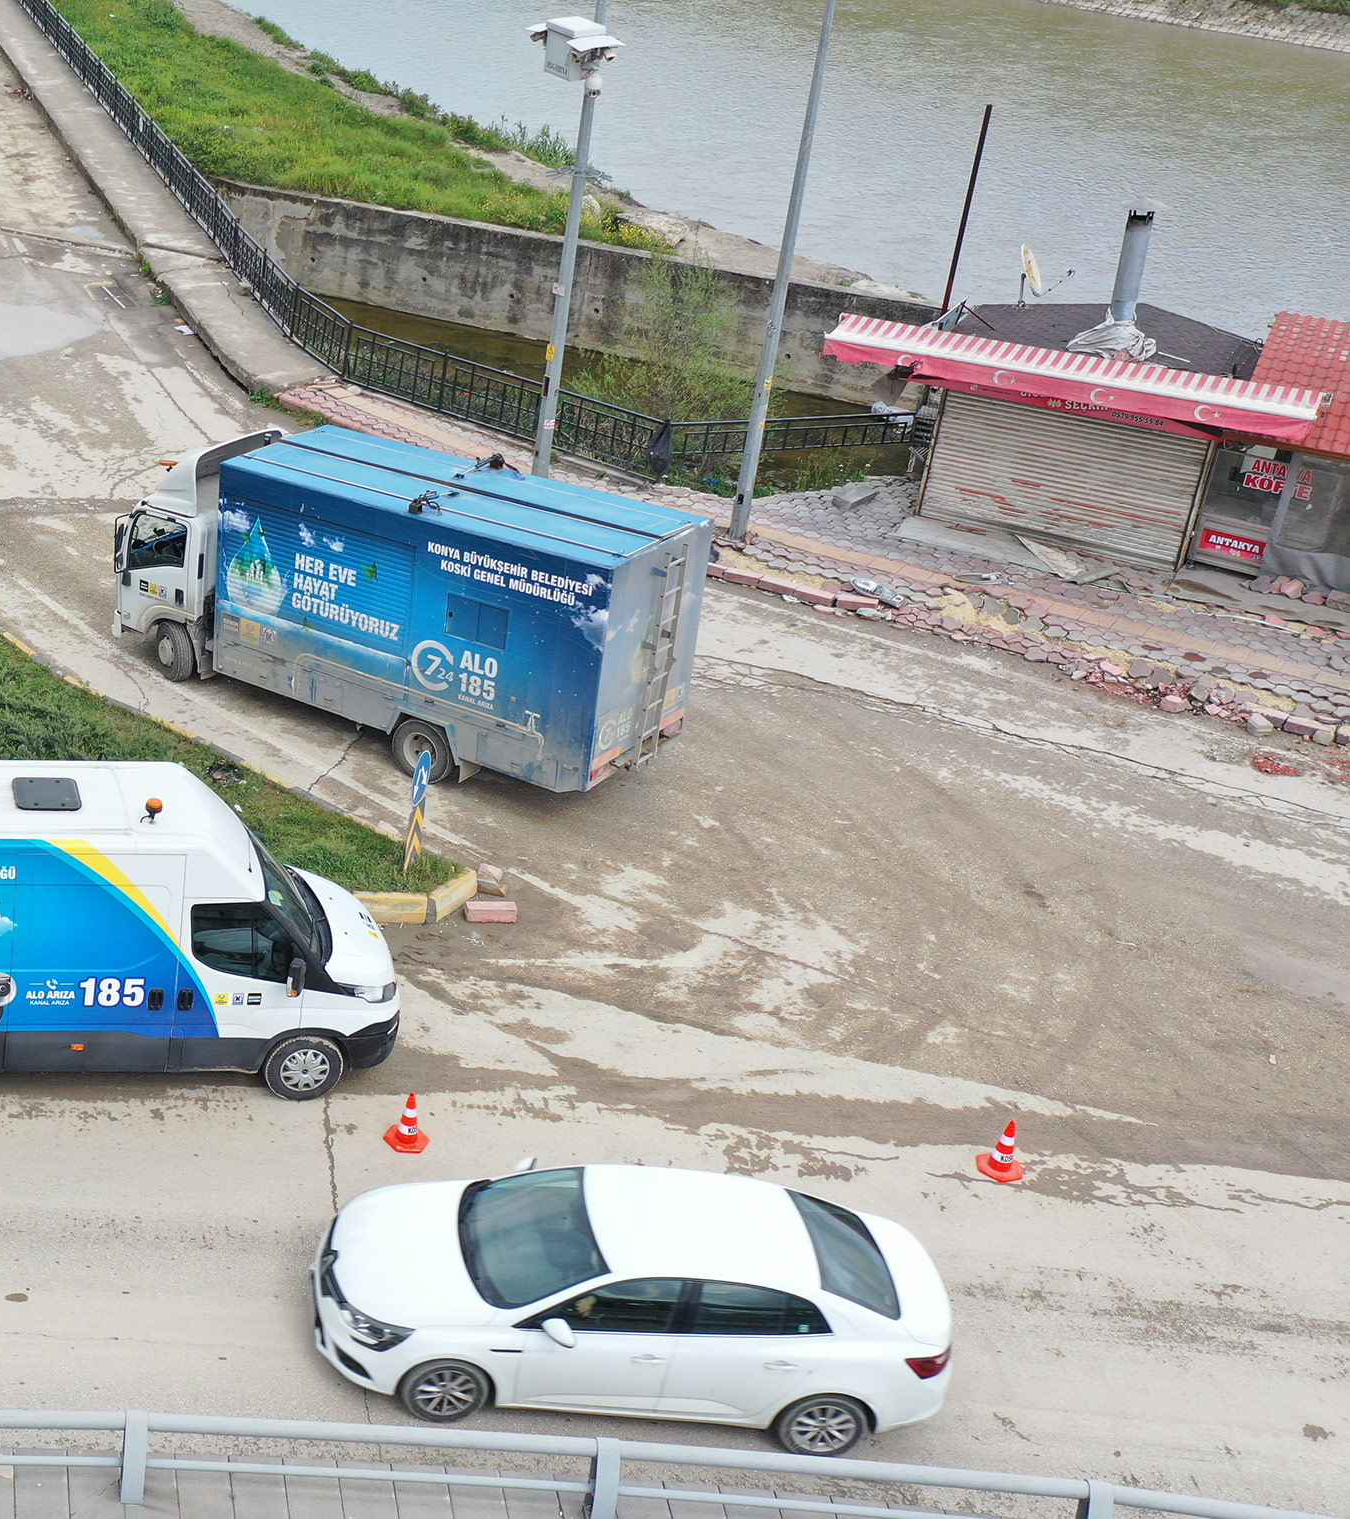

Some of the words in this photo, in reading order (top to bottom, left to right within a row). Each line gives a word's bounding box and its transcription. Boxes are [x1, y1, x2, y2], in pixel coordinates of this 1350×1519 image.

[1251, 459, 1314, 484] ANTAYA
[1243, 473, 1312, 500] KÖFE
[1208, 534, 1261, 554] ANTAKYA
[294, 552, 325, 577] HER
[328, 563, 357, 587] EVE
[427, 541, 461, 561] KONYA
[463, 551, 529, 580] BÜYÜKŞEHİR
[293, 572, 340, 601] HAYAT
[440, 559, 472, 578] KOSKİ
[473, 569, 507, 588] GENEL
[508, 578, 576, 607] MÜDÜRLÜĞÜ
[291, 591, 402, 641] GÖTÜRÜYORUZ
[424, 653, 443, 676] 7
[437, 667, 455, 683] 24
[459, 649, 499, 679] ALO
[458, 672, 496, 701] 185
[457, 693, 477, 705] KANAL
[476, 699, 495, 711] ARIZA
[26, 991, 45, 999] ALO
[46, 991, 75, 1000] ARIZA
[79, 977, 146, 1007] 185
